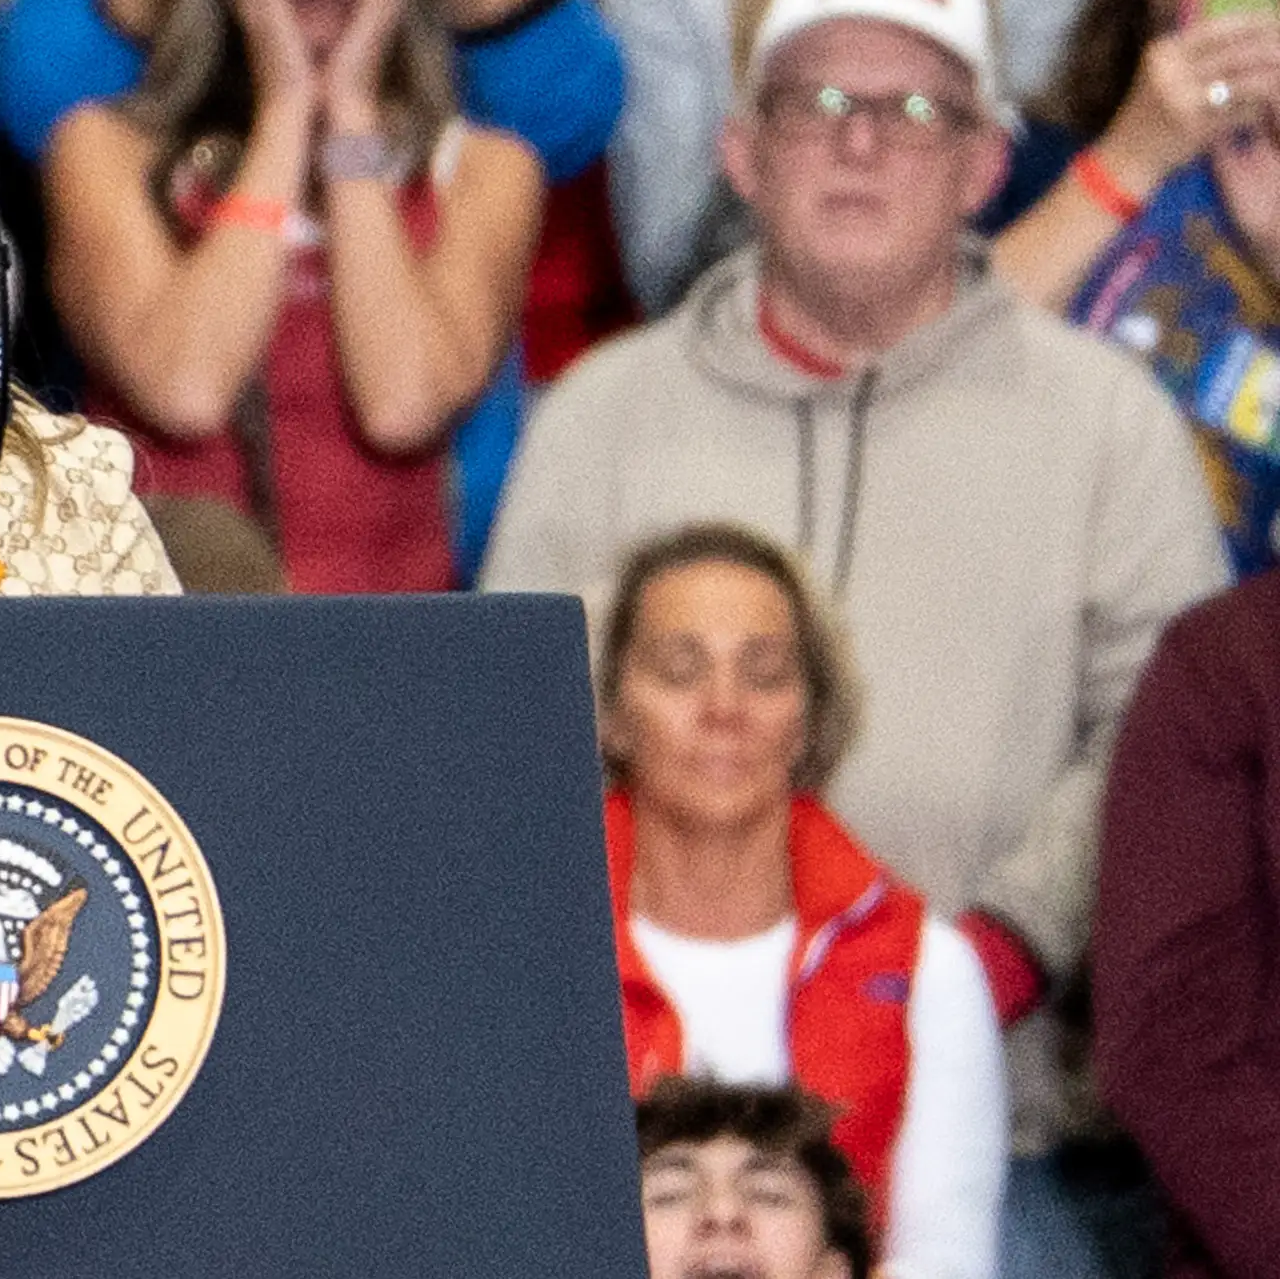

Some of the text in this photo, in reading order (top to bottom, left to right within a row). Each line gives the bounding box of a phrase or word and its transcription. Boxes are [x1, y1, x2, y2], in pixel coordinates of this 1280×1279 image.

[4, 742, 48, 773] OF
[58, 756, 115, 807] THE
[121, 806, 208, 1002] UNITED
[13, 1045, 180, 1177] STATES
